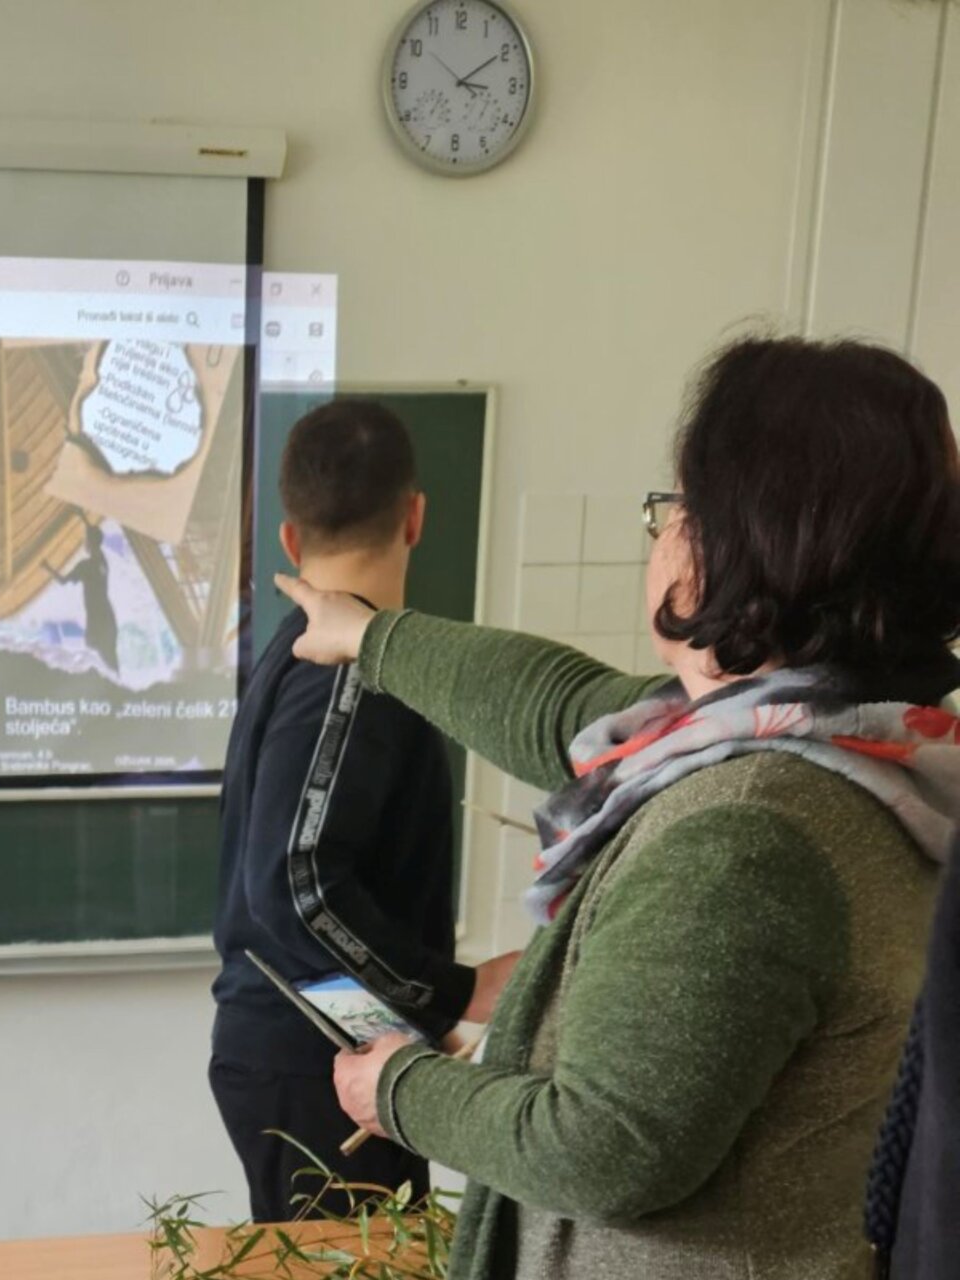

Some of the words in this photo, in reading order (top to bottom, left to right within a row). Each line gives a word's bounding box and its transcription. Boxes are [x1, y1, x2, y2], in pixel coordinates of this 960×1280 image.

[428, 16, 439, 36] 11
[455, 11, 468, 30] 12
[410, 39, 423, 57] 10
[501, 43, 510, 62] 2
[508, 77, 517, 95] 3
[149, 272, 193, 290] Prijava
[5, 697, 75, 715] Bambus
[79, 698, 111, 716] kao
[175, 701, 214, 719] čelik
